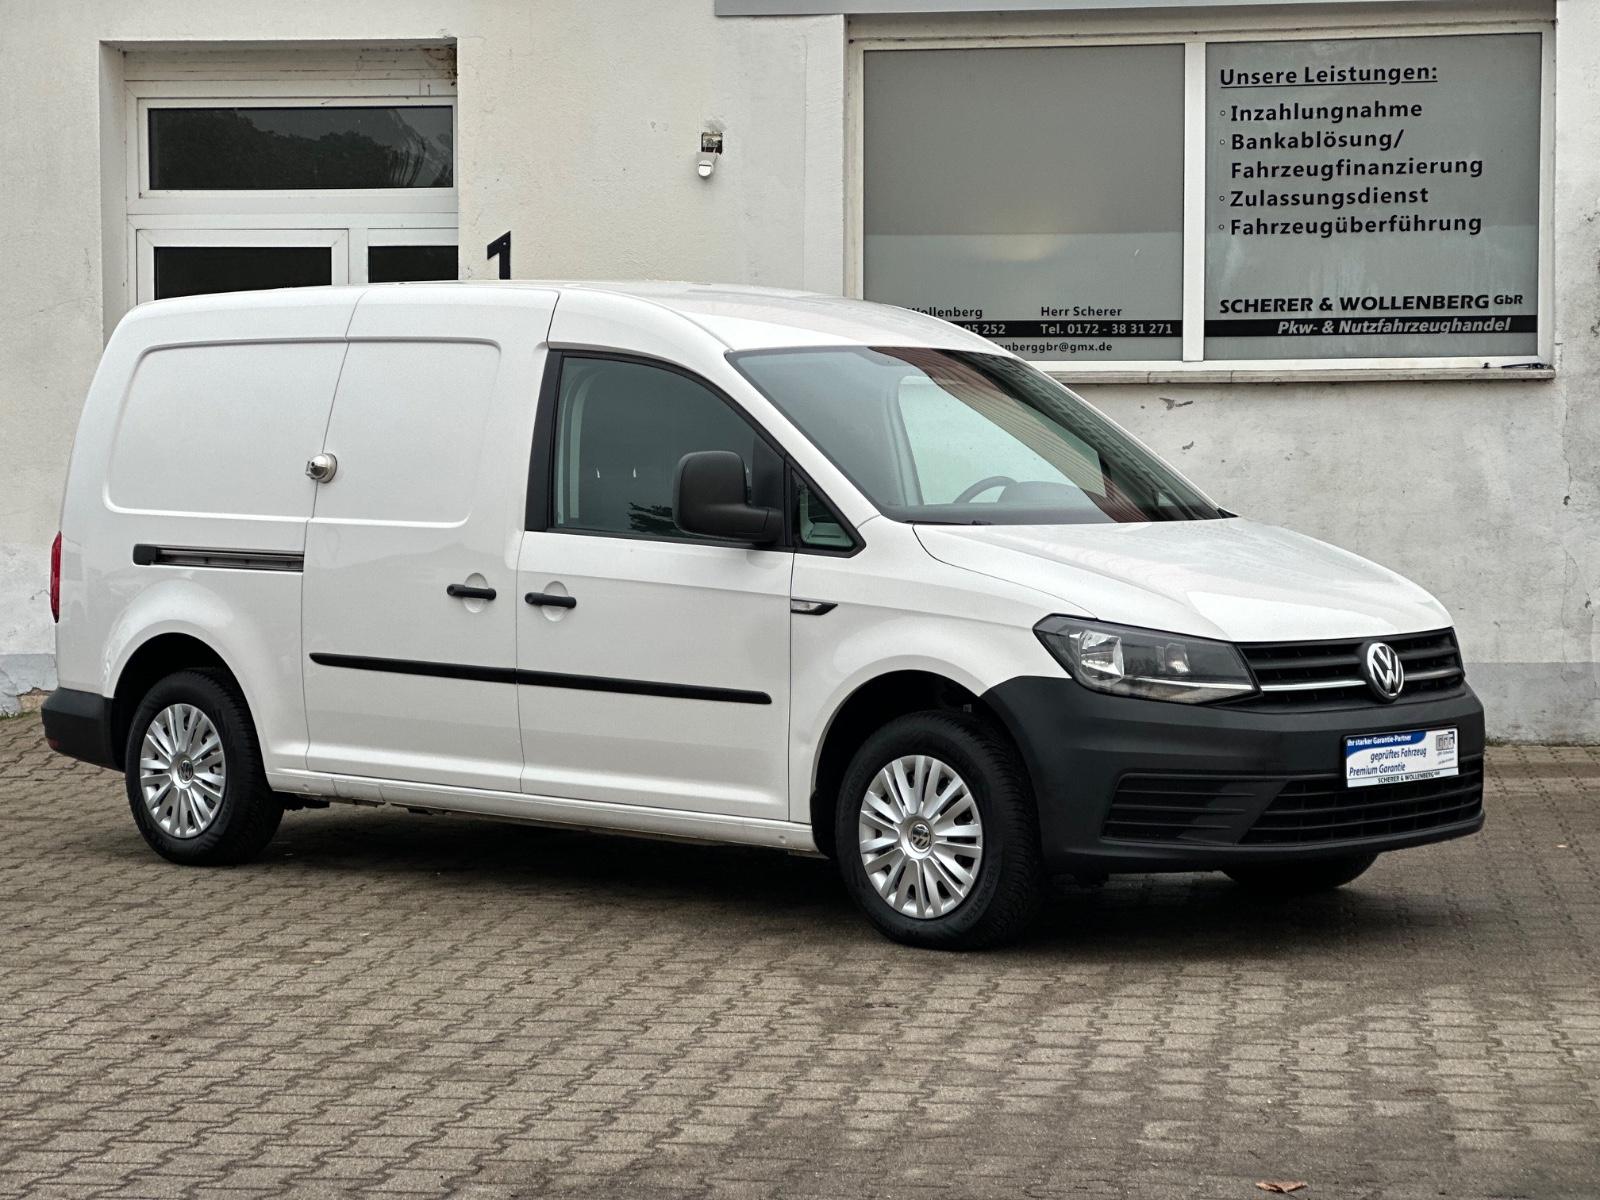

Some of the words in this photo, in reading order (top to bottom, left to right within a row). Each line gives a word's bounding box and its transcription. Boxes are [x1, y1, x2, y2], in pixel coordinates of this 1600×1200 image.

[1220, 67, 1297, 86] Unsere
[1305, 64, 1438, 85] Leistungen:
[1230, 100, 1423, 123] Inzahlungnahme
[1231, 129, 1405, 151] Bankablösung/
[1231, 158, 1484, 181] Fahrzeugfinanzierung
[1230, 186, 1429, 209] Zulassungsdienst
[1230, 214, 1482, 238] Fahrzeugüberführung
[487, 230, 511, 280] 1
[1041, 306, 1070, 316] Herr
[1073, 306, 1123, 316] Scherer
[1219, 297, 1314, 314] SCHERER
[1319, 296, 1334, 312] &
[1339, 294, 1490, 311] WOLLENBERG
[1494, 294, 1524, 306] GbR
[982, 324, 1006, 334] 252
[1040, 324, 1064, 334] Tel.
[1067, 324, 1099, 334] 0172
[1111, 324, 1126, 334] 38
[1130, 323, 1145, 334] 31
[1149, 323, 1173, 334] 271
[1277, 320, 1318, 335] Pkw-
[1321, 320, 1335, 334] &
[1338, 317, 1512, 336] Nutzfahrzeughandel
[995, 342, 1113, 353] nberggbr@gmx.de
[1370, 749, 1400, 763] geprüftes
[1400, 747, 1427, 758] Fahrzeug
[1349, 766, 1378, 776] Premium
[1378, 762, 1406, 774] Garantie
